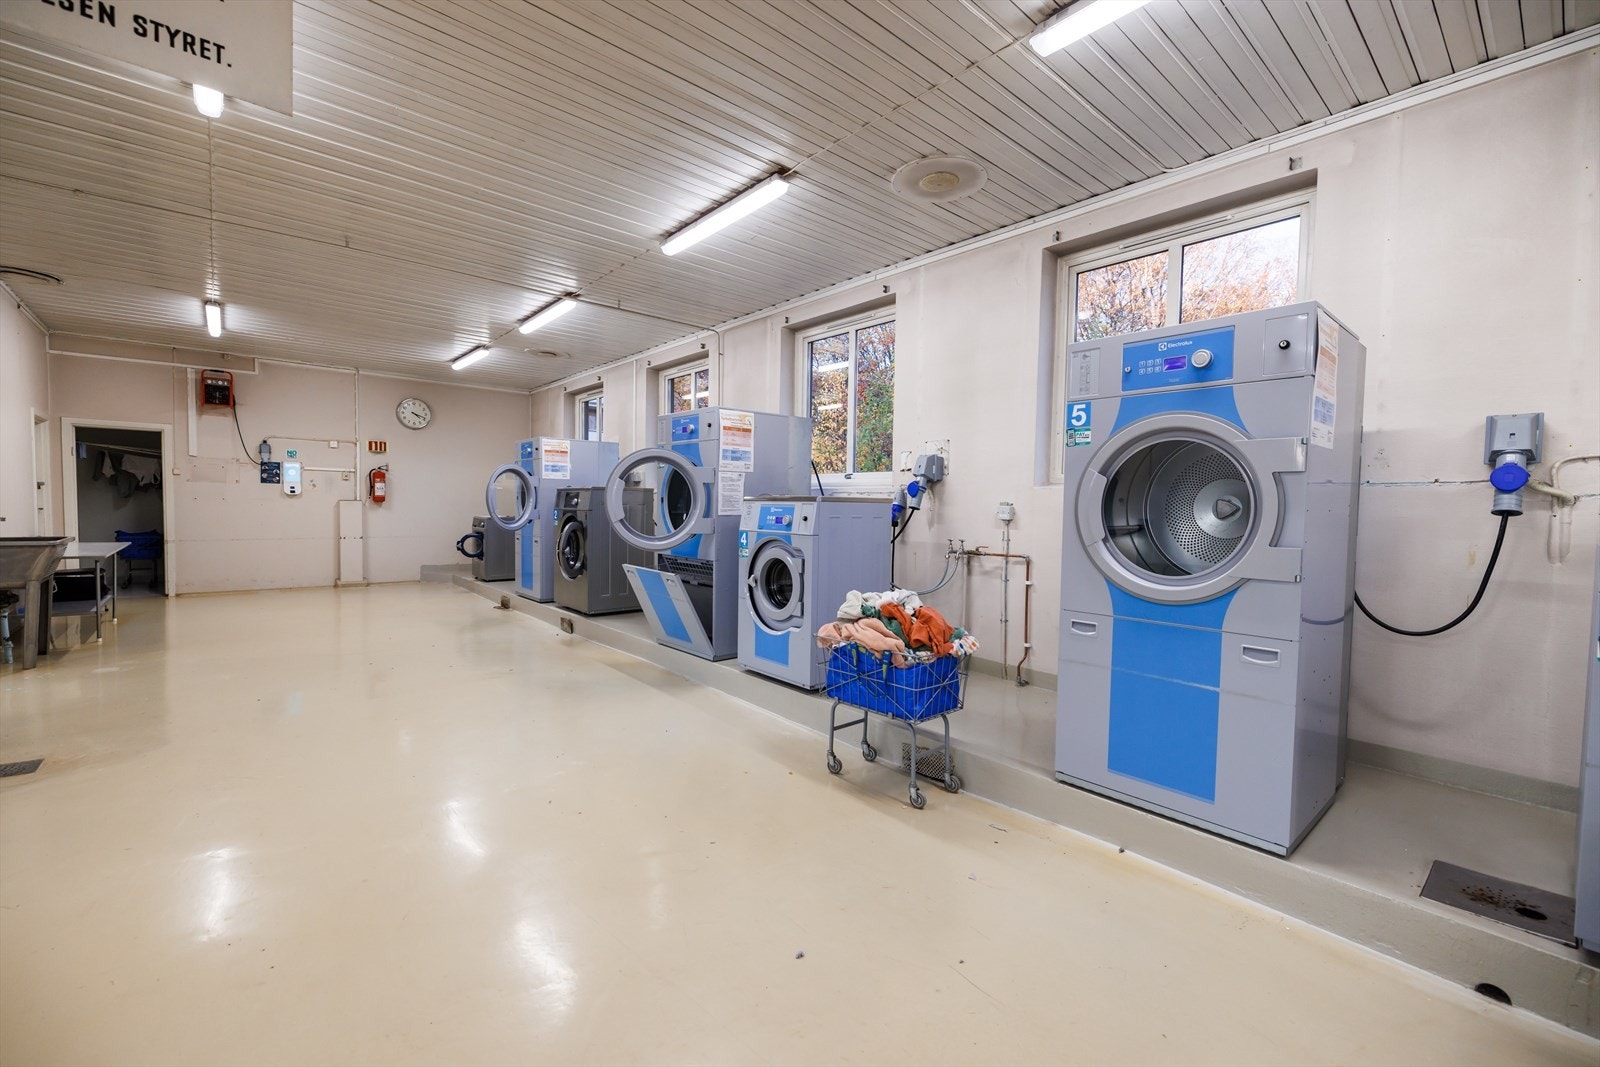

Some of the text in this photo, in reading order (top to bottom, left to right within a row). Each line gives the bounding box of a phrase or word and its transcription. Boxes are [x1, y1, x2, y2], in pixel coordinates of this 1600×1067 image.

[42, 0, 232, 68] SEN STYRET.
[1167, 340, 1193, 348] Electrolux
[1071, 404, 1087, 426] 5
[553, 510, 558, 519] 2
[740, 532, 747, 545] 4
